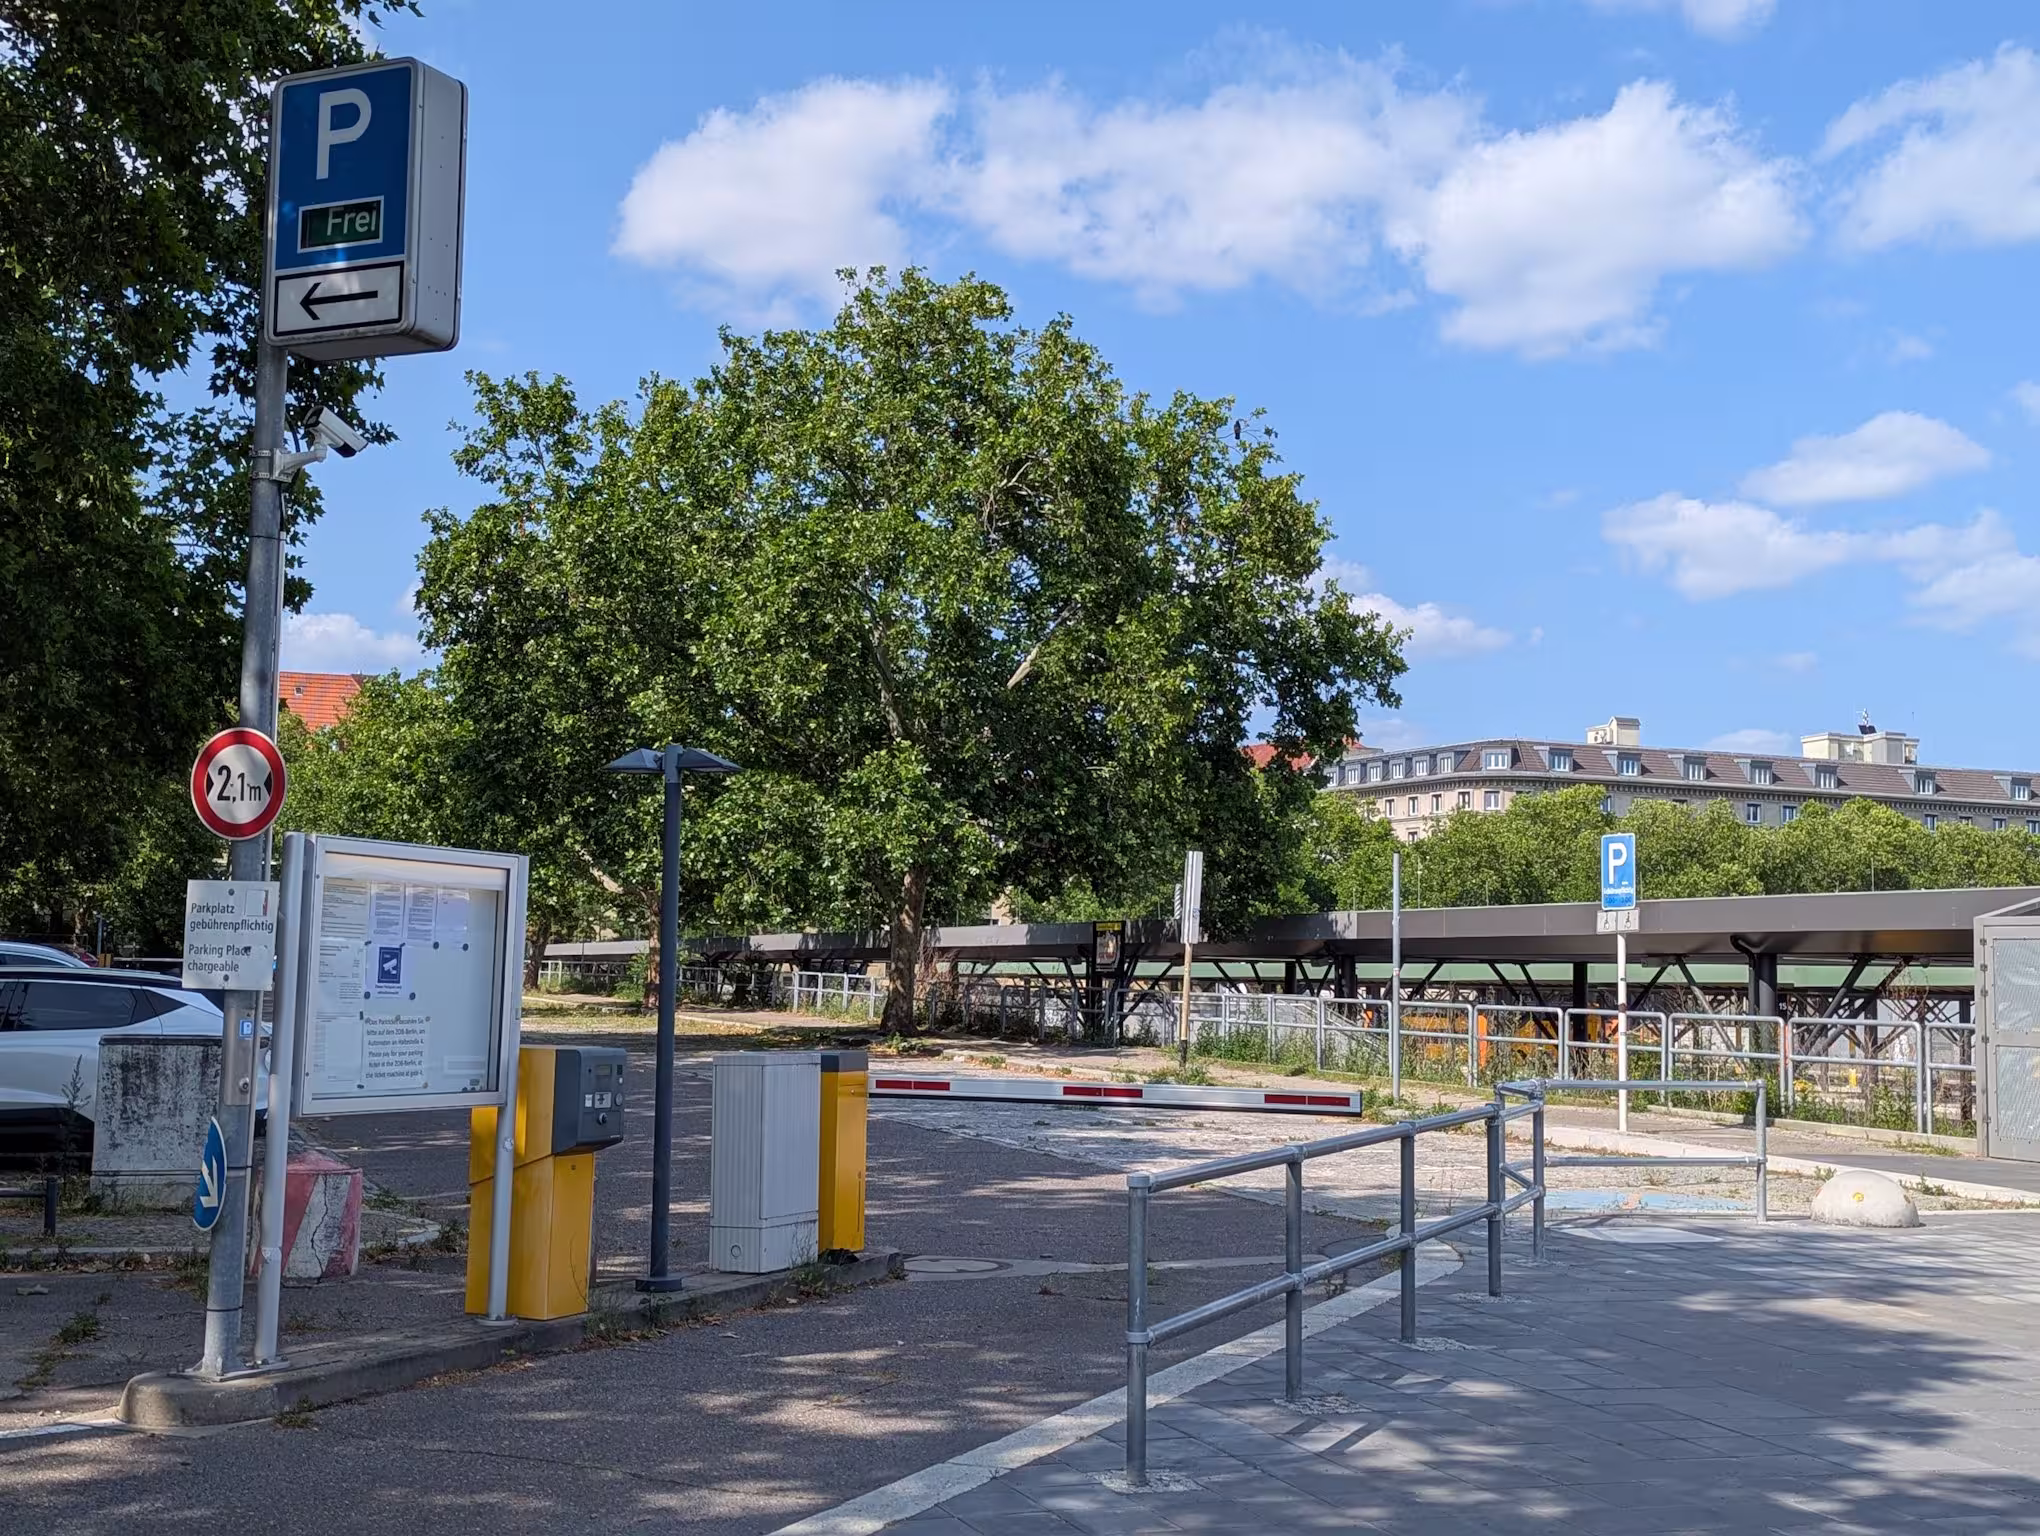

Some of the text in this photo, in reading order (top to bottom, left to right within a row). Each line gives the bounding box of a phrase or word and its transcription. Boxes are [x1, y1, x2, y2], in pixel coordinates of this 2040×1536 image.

[316, 88, 372, 180] P
[326, 202, 378, 236] Frei
[1609, 842, 1627, 885] P
[190, 902, 236, 916] Parkplatz
[189, 919, 274, 934] gebührenpflichtig
[188, 943, 224, 958] Parking
[187, 960, 240, 974] chargeable
